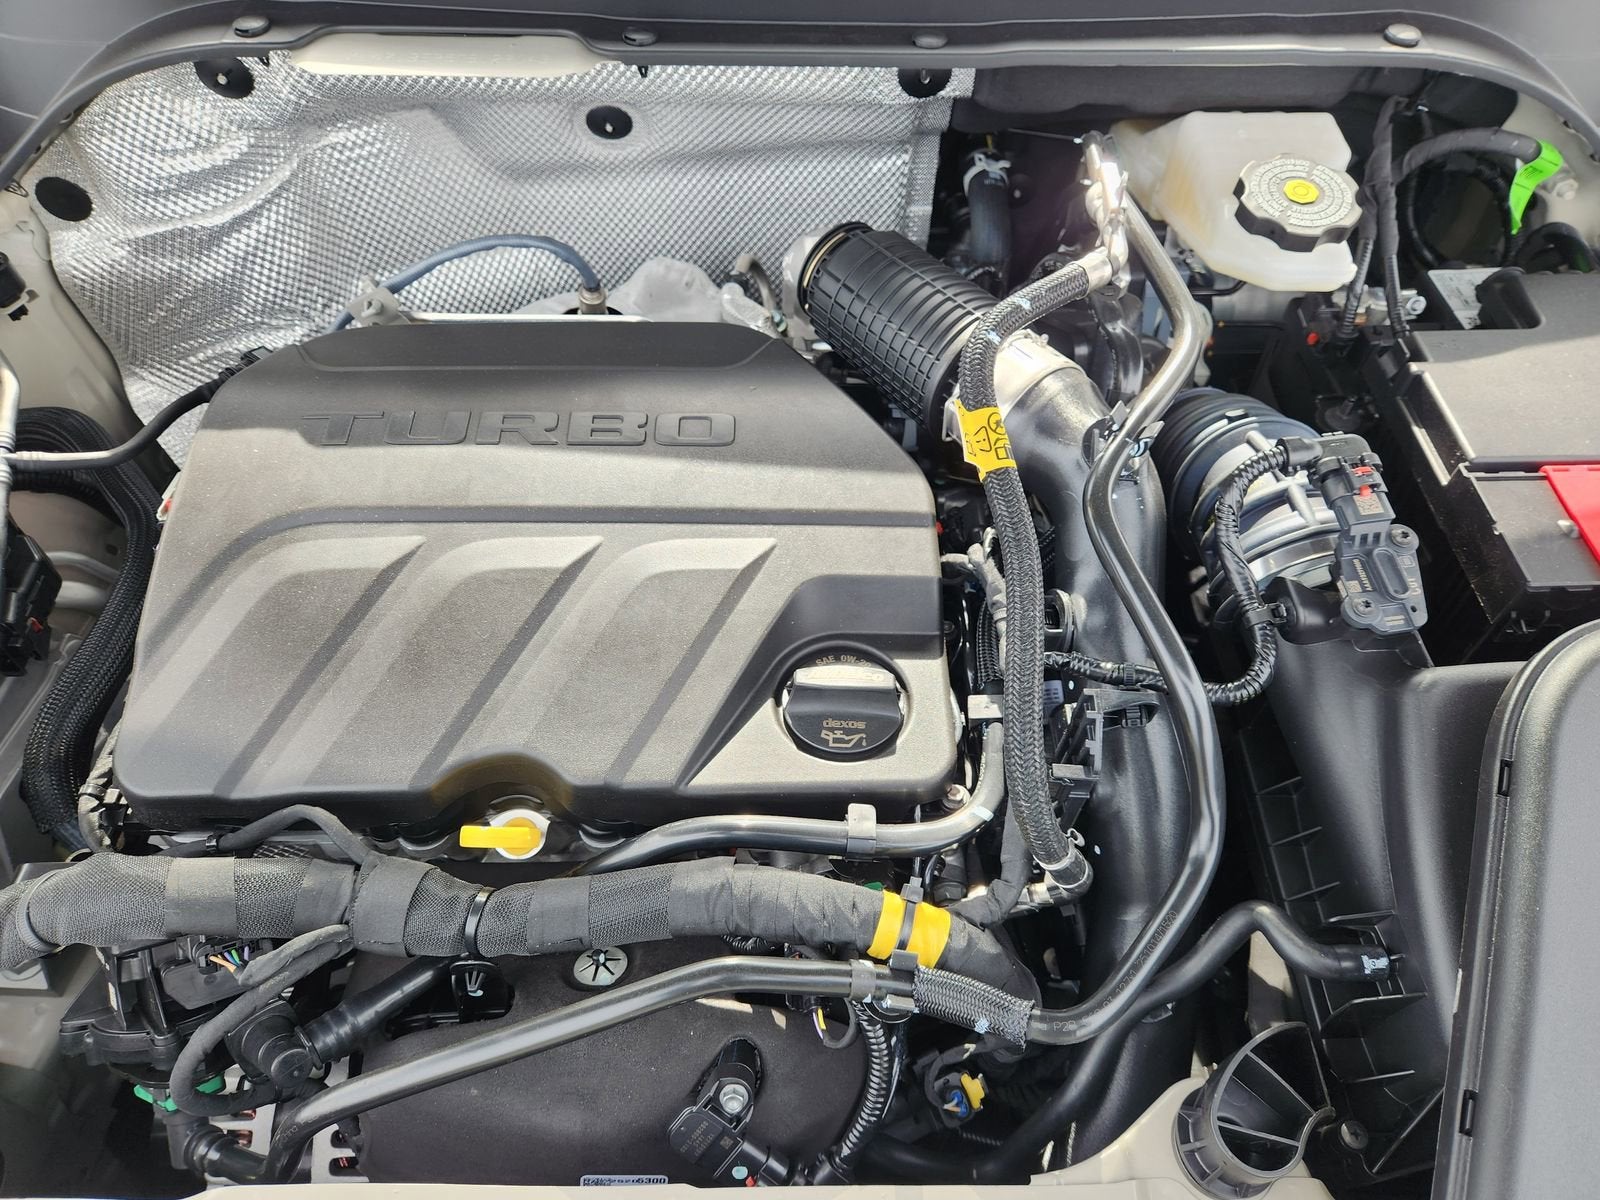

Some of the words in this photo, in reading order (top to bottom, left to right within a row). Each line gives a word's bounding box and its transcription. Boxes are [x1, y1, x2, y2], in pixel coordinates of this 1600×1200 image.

[301, 411, 737, 447] TURBO
[815, 655, 836, 666] SAE
[822, 718, 866, 729] dexos
